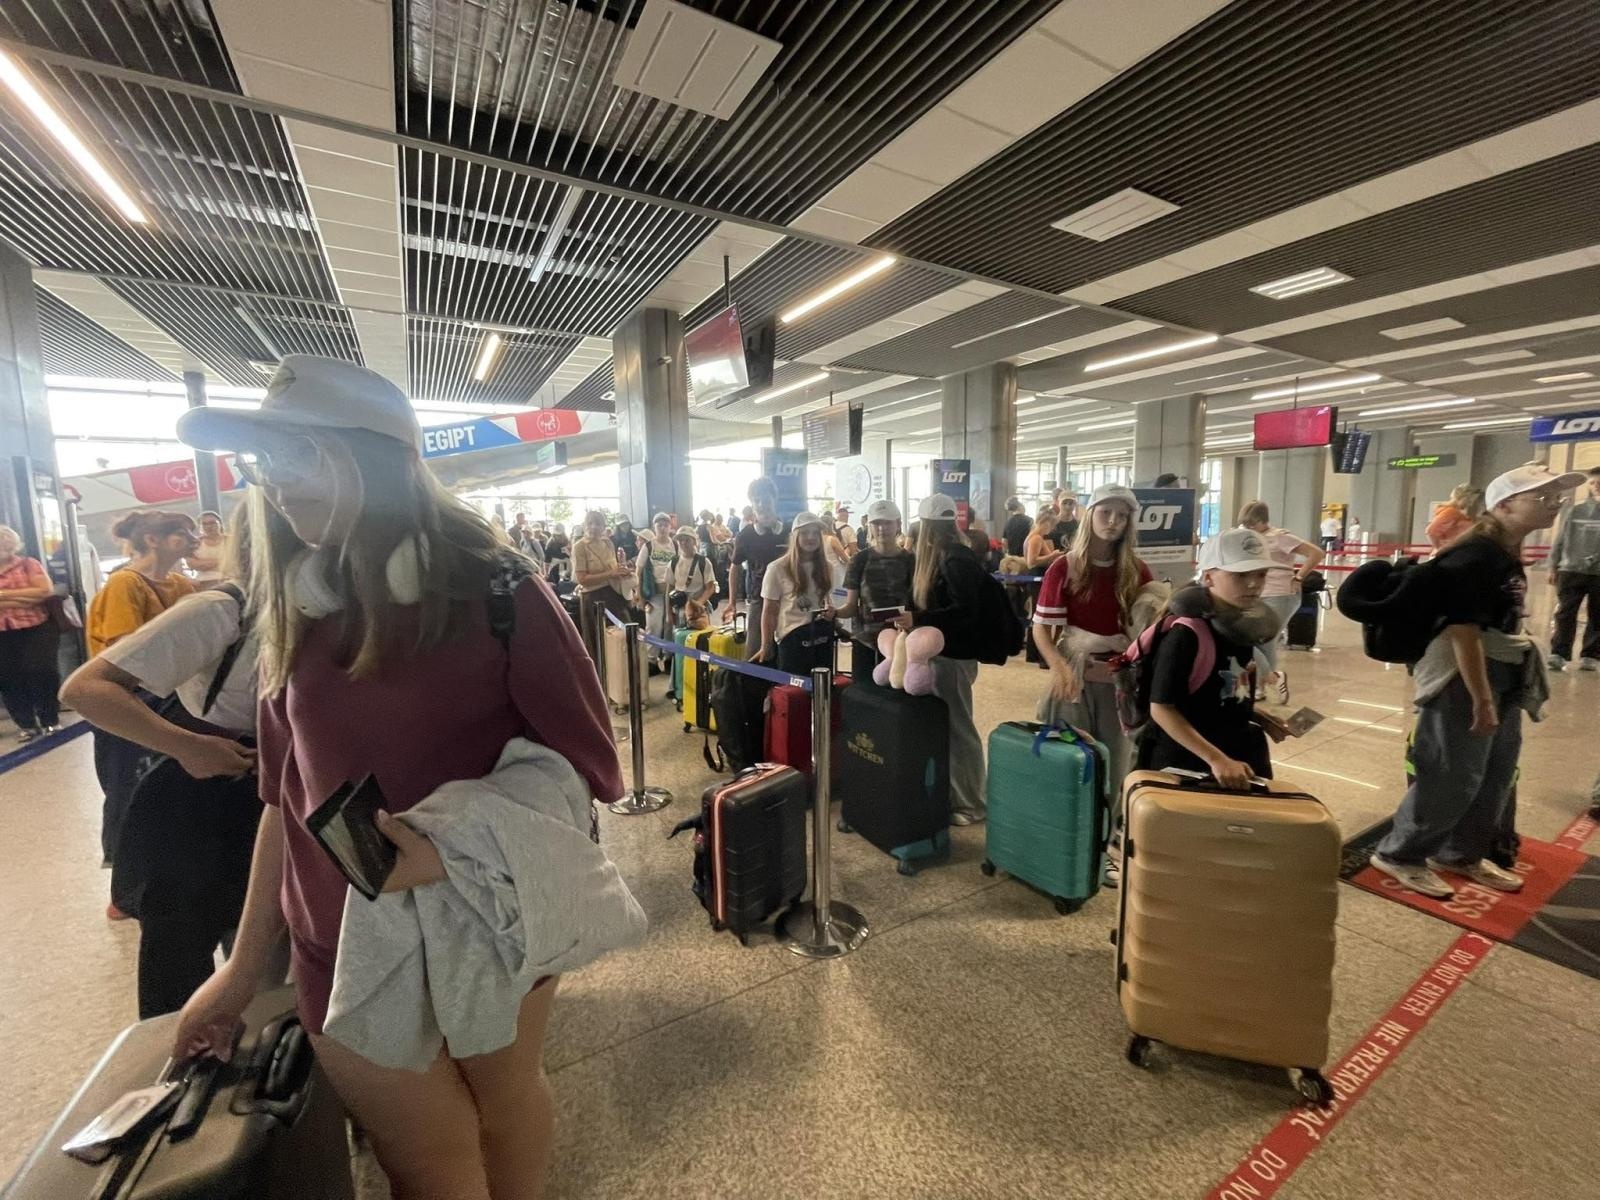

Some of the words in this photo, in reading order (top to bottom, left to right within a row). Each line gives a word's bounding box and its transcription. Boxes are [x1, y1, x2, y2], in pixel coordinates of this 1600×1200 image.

[1551, 417, 1600, 436] LOT
[424, 427, 475, 453] EGIPT
[775, 462, 804, 477] LOT
[942, 471, 967, 483] LOT
[790, 676, 805, 688] LOT
[1449, 949, 1477, 965] DO
[1432, 962, 1464, 985] NOT
[1401, 981, 1446, 1017] ENTER
[1374, 1019, 1411, 1047] NIE
[1250, 1148, 1287, 1180] DO
